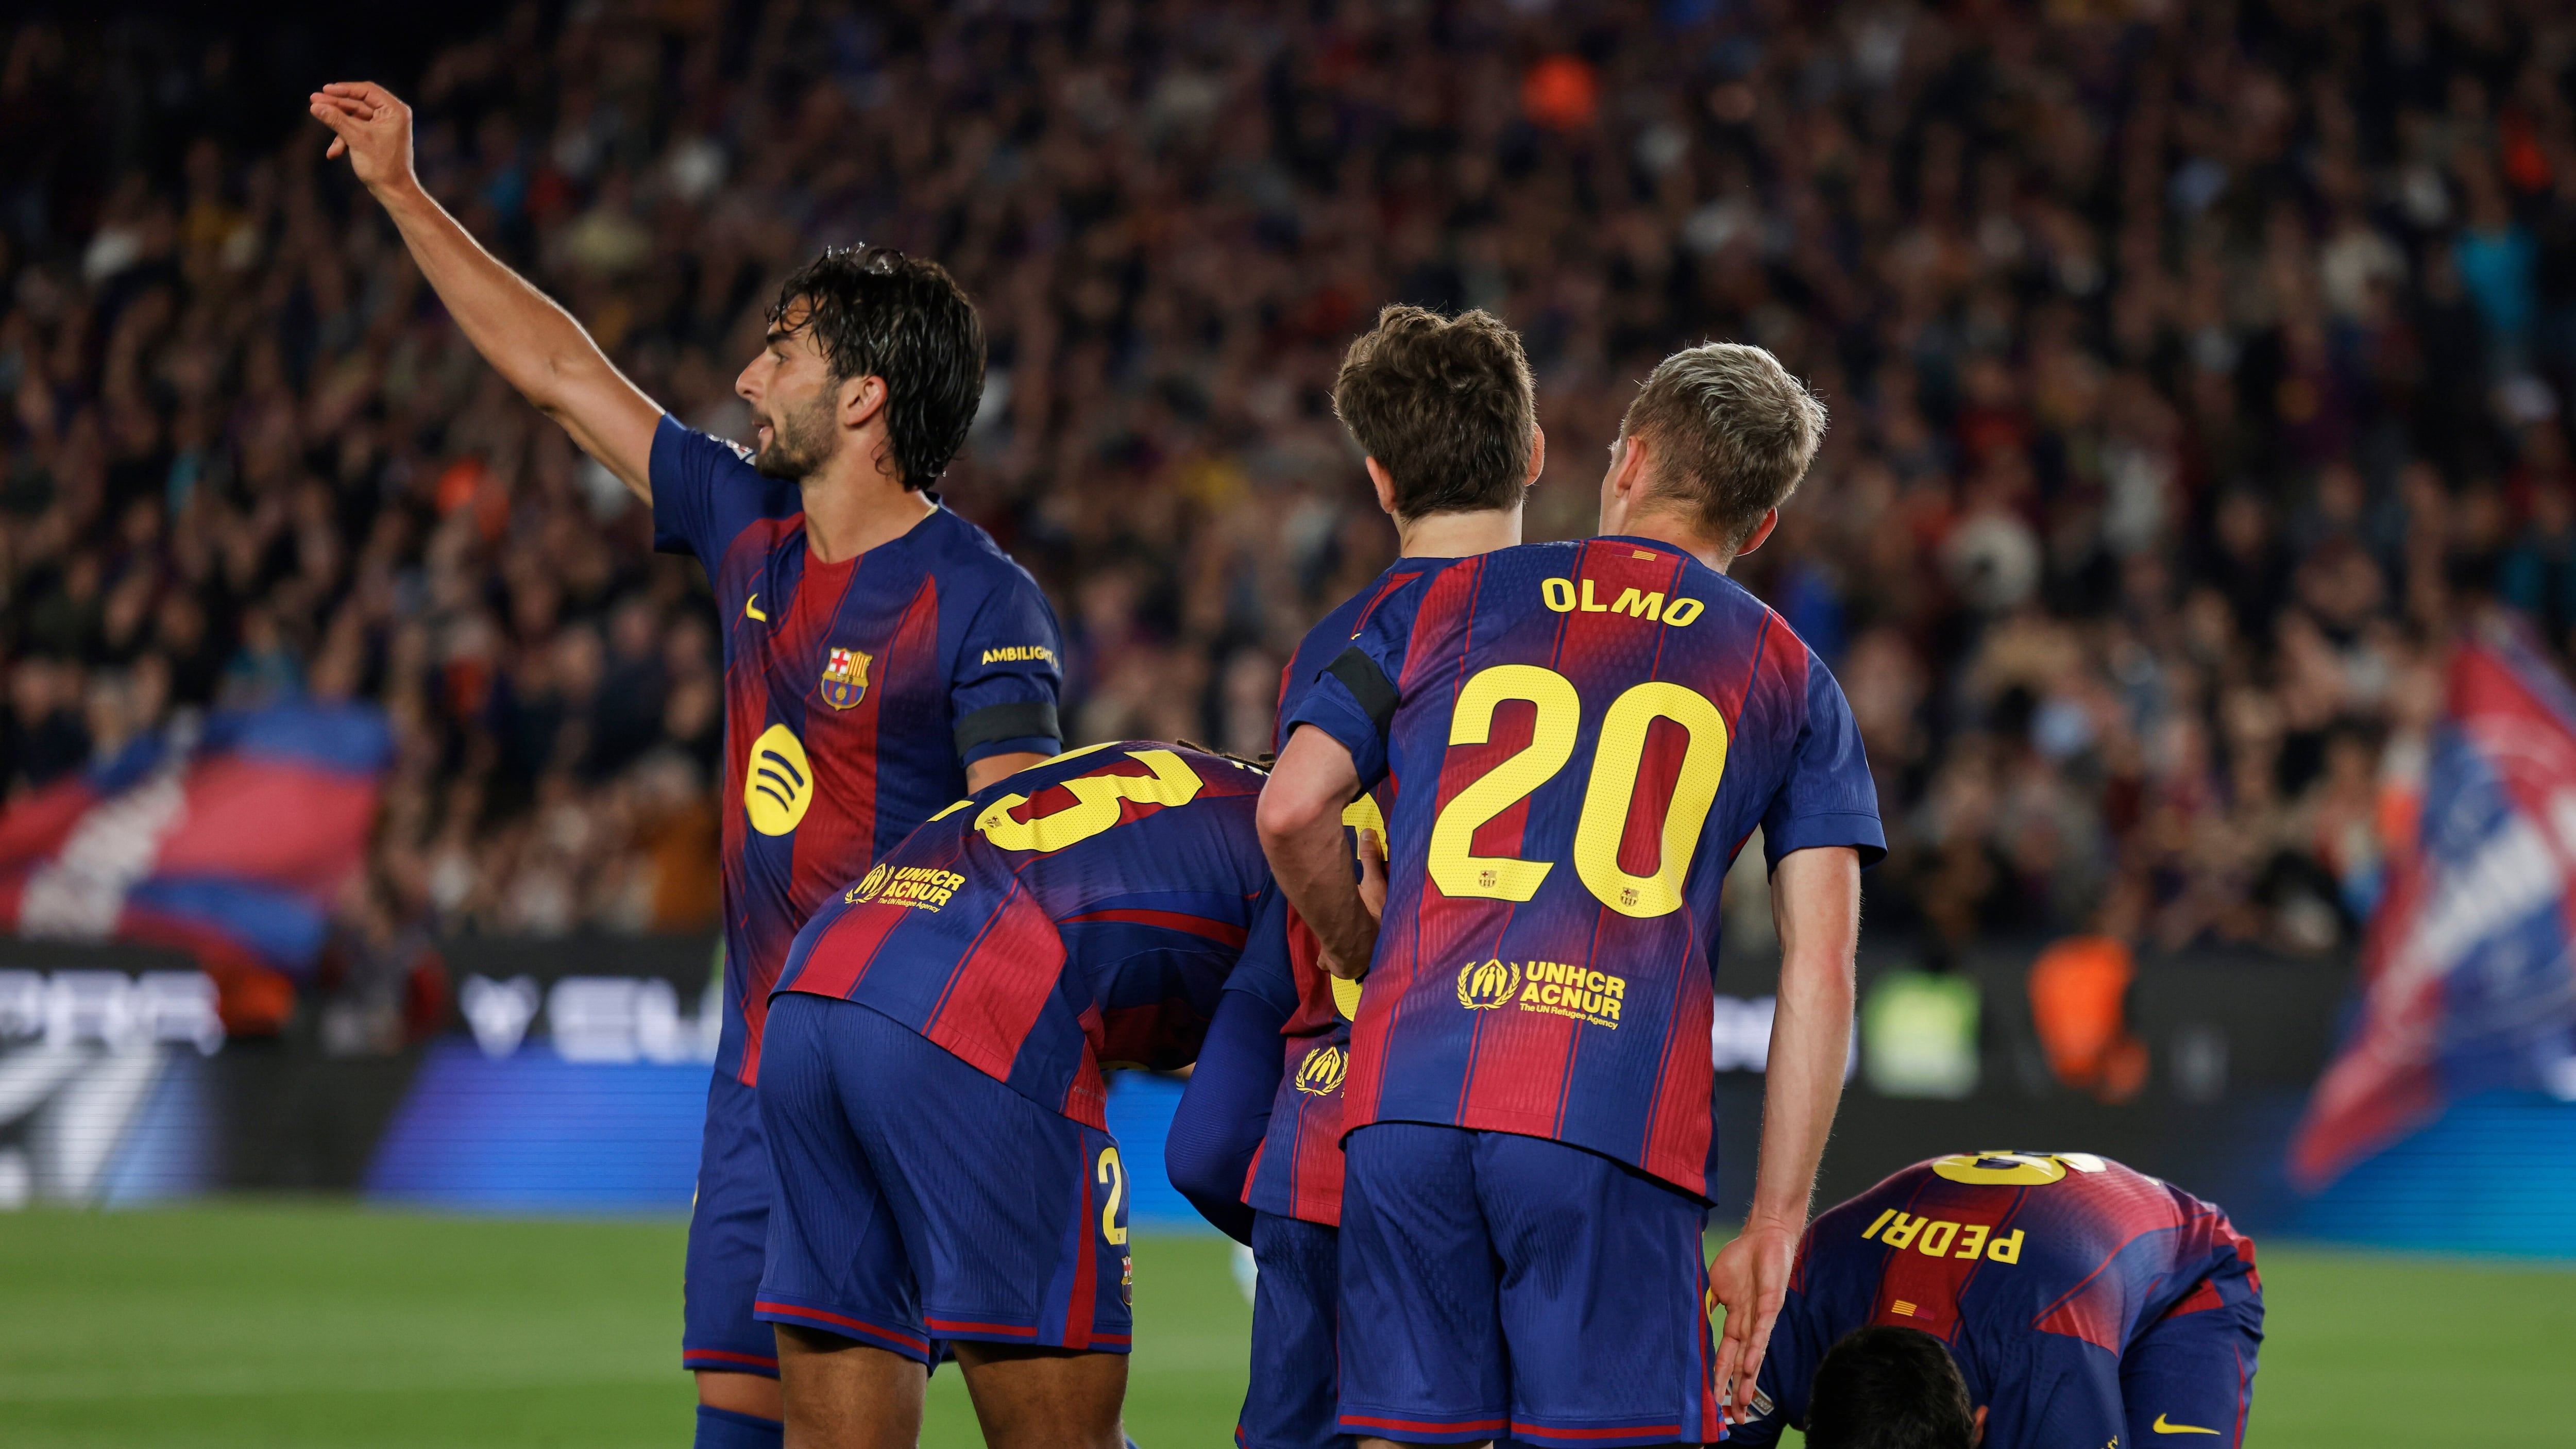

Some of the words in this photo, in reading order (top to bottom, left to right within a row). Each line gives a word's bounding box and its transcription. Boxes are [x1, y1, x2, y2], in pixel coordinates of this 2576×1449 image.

[1541, 577, 1705, 627] OLMO
[981, 646, 1054, 665] AMBILIGHT
[1427, 664, 1729, 918] 20
[882, 880, 953, 906] ACNUR
[894, 866, 966, 891] UNHCR
[895, 899, 917, 907] Refugee
[917, 901, 941, 913] Agency
[1526, 961, 1626, 1000] UNHCR
[1519, 982, 1622, 1020] ACNUR
[1520, 1003, 1535, 1012] The
[1536, 1004, 1550, 1014] UN
[1550, 1006, 1586, 1020] Refugee
[1586, 1015, 1619, 1030] Agency
[1861, 1207, 2026, 1266] PEDRI
